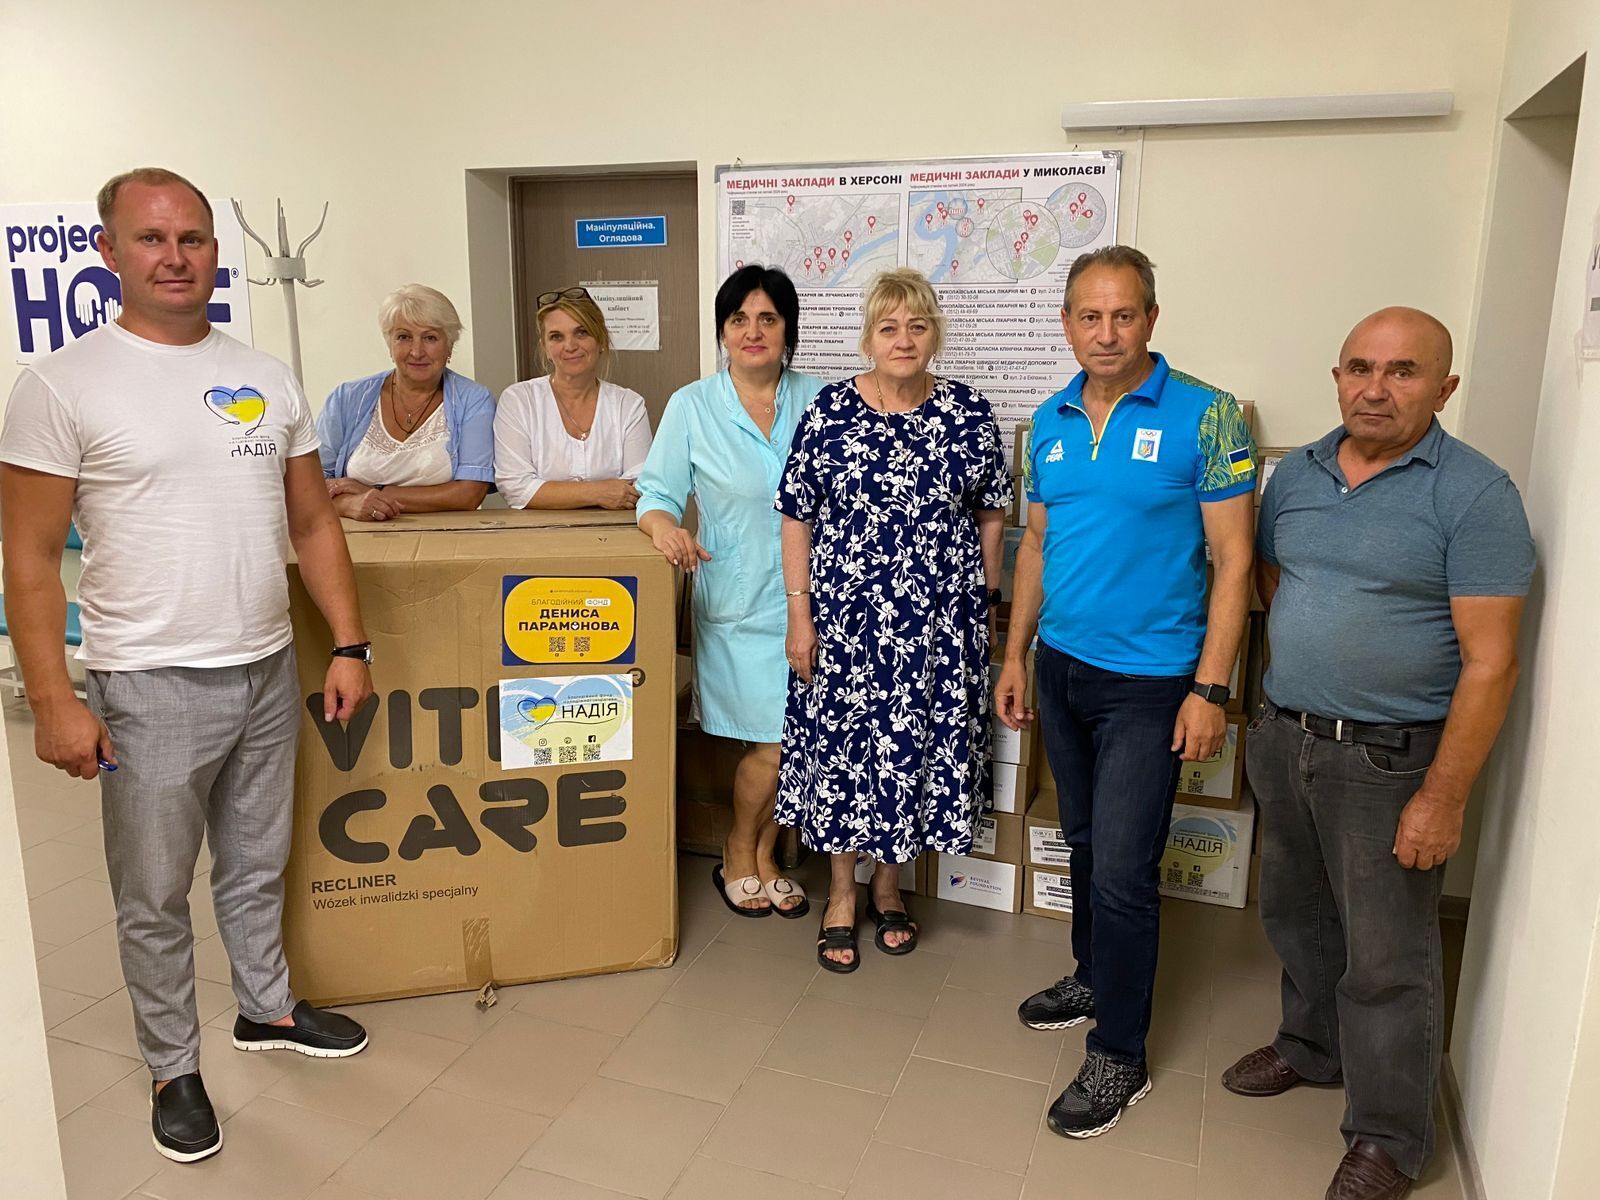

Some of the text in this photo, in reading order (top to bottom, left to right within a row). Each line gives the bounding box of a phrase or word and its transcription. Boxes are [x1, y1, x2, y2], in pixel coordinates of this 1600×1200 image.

[910, 166, 1105, 182] МЕДИЧНІ ЗАКЛАДИ У МИКОЛАЄВІ
[726, 178, 777, 190] МЕДИЧНІ
[782, 177, 835, 188] ЗАКЛАДИ
[839, 177, 846, 186] В
[850, 175, 902, 186] ХЕРСОНІ
[586, 222, 656, 232] Маніпуляційна.
[6, 215, 103, 263] projec
[598, 234, 642, 243] Оглядова
[231, 443, 277, 457] НАДІЯ
[1045, 451, 1066, 464] PEAK
[531, 598, 584, 606] БЛАГОДІЙНИЙ
[540, 608, 600, 619] ДЕНИСА
[518, 621, 620, 631] ПАРАМОНОВА
[562, 702, 618, 718] НАДІЯ
[318, 770, 627, 864] CARE
[1173, 836, 1223, 854] НАДІЯ
[312, 874, 397, 893] RECLINER
[313, 885, 478, 910] Wózek inwalidzki specjalny
